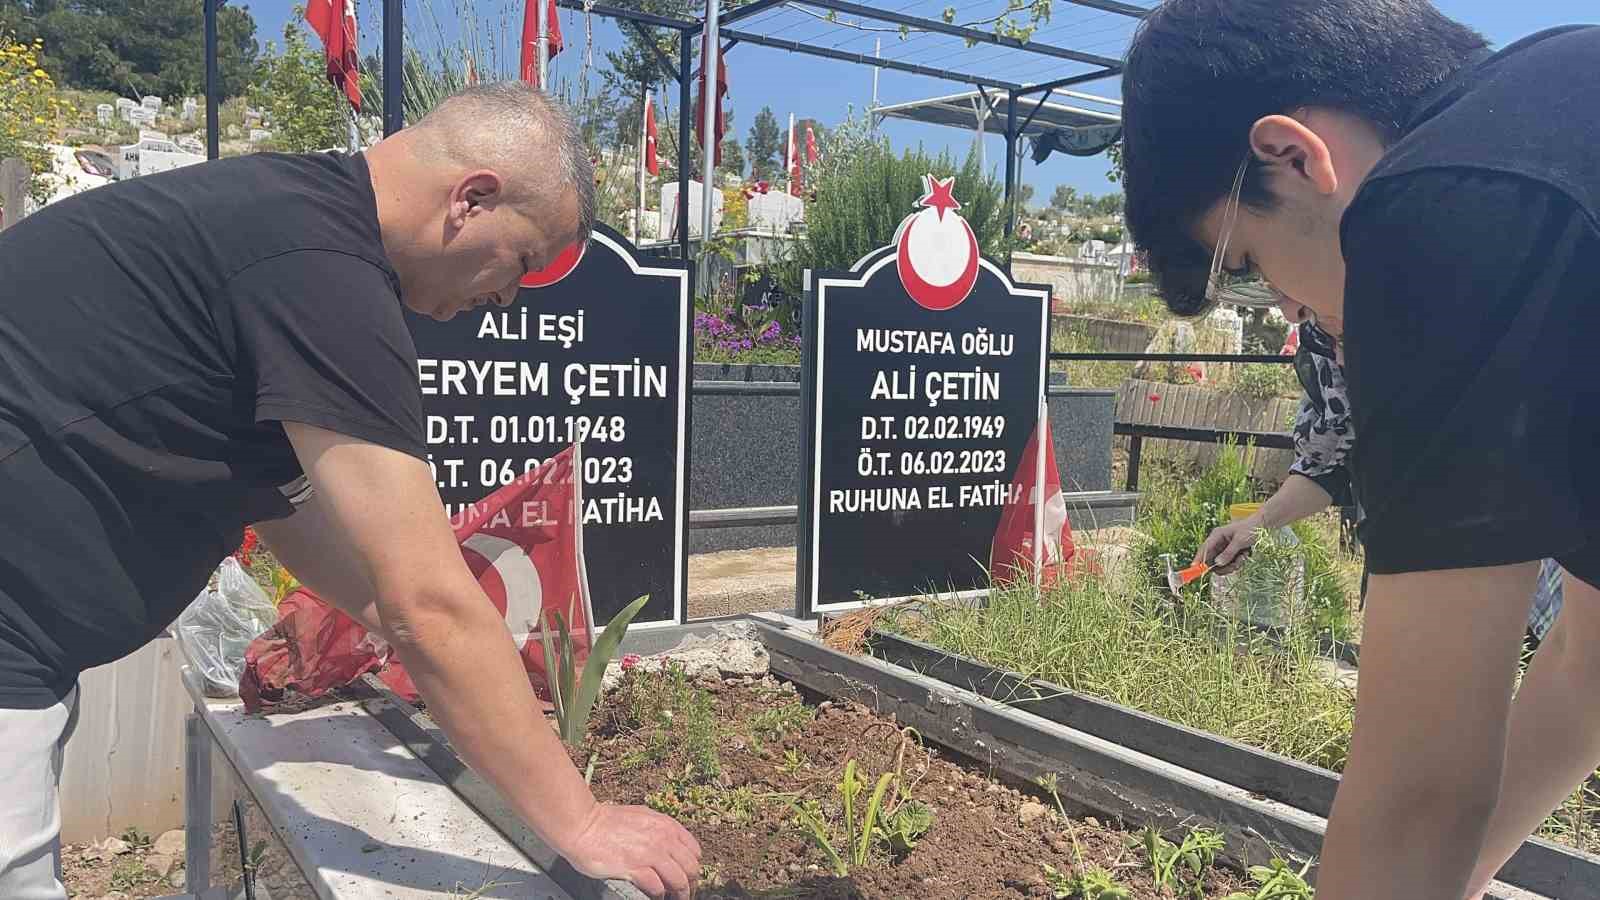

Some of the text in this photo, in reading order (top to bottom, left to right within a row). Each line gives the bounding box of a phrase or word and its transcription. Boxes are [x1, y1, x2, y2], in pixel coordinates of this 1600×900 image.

[477, 306, 584, 349] ALİ EŞİ
[856, 327, 1014, 356] MUSTAFA OĞLU
[417, 357, 668, 405] ERYEM ÇETİN
[870, 365, 1000, 407] ALİ ÇETİN
[427, 415, 626, 444] D.T. 01.01.1948
[861, 416, 1005, 440] D.T. 02.02.1949
[857, 448, 1006, 476] Ö.T. 06.02.2023
[522, 501, 558, 527] EL
[829, 487, 922, 513] RUHUNA
[928, 486, 953, 509] EL
